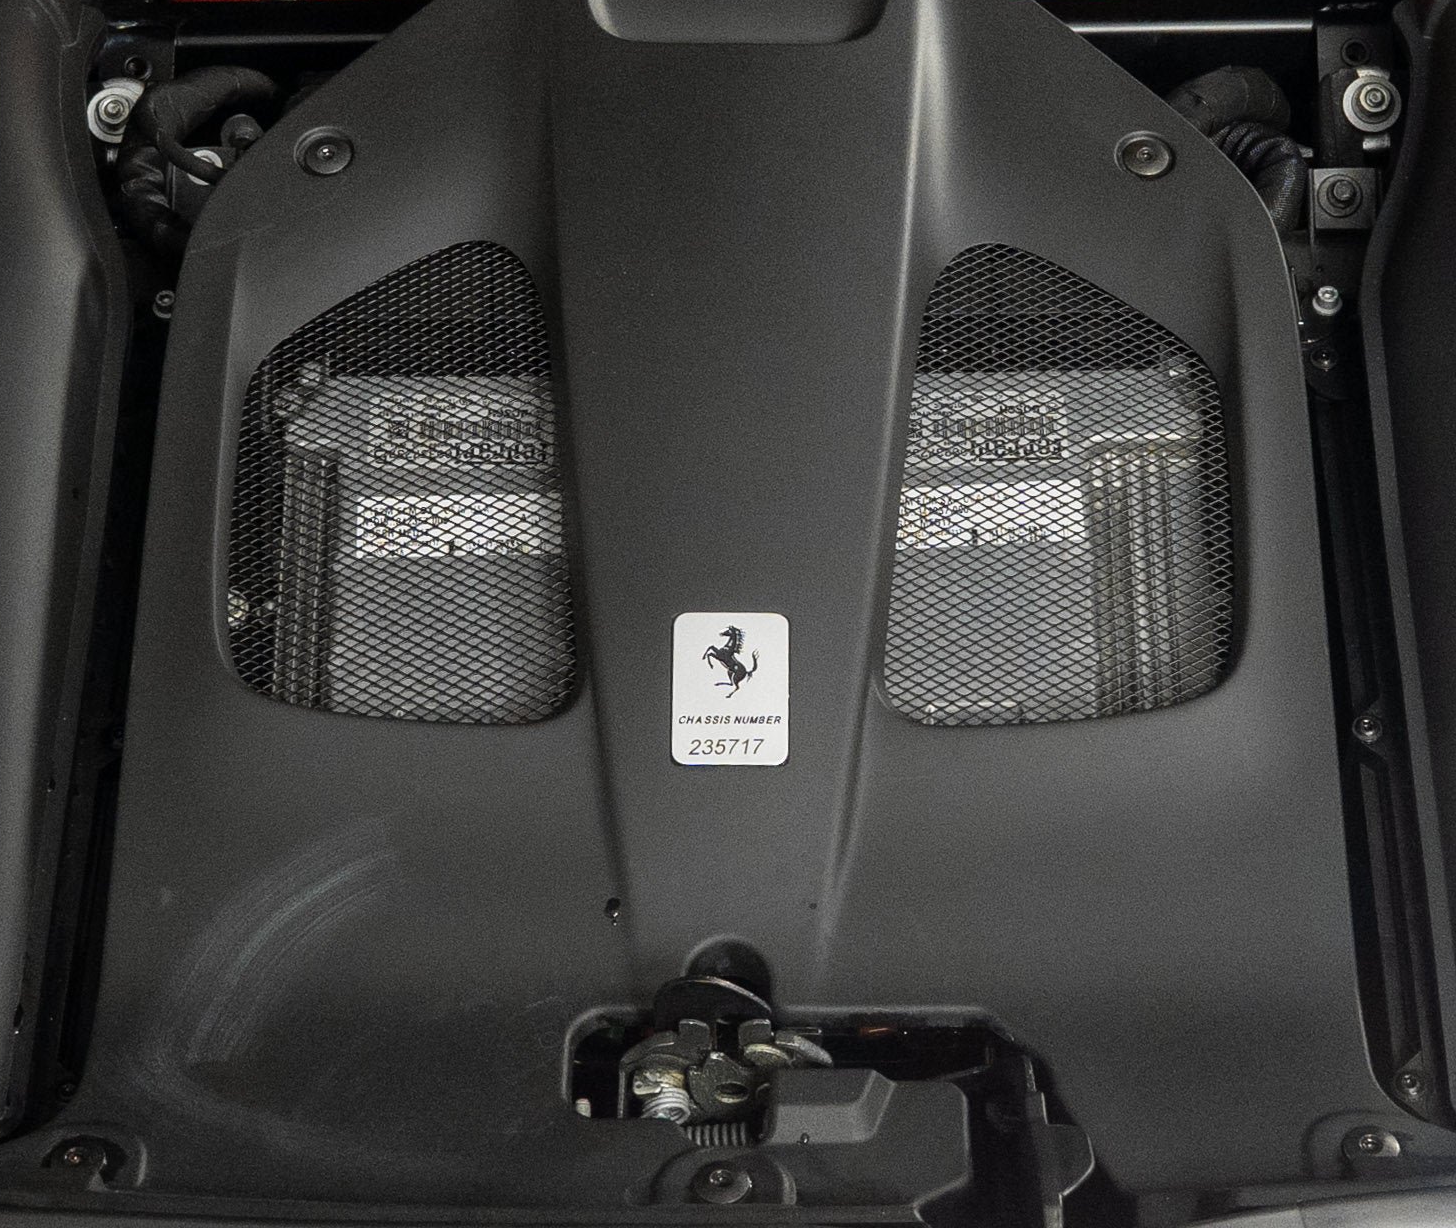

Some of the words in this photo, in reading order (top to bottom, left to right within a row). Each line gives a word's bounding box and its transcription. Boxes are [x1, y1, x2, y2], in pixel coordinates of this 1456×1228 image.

[678, 715, 731, 725] CHASSIS
[733, 715, 782, 725] NUMBER
[688, 738, 765, 756] 235717
